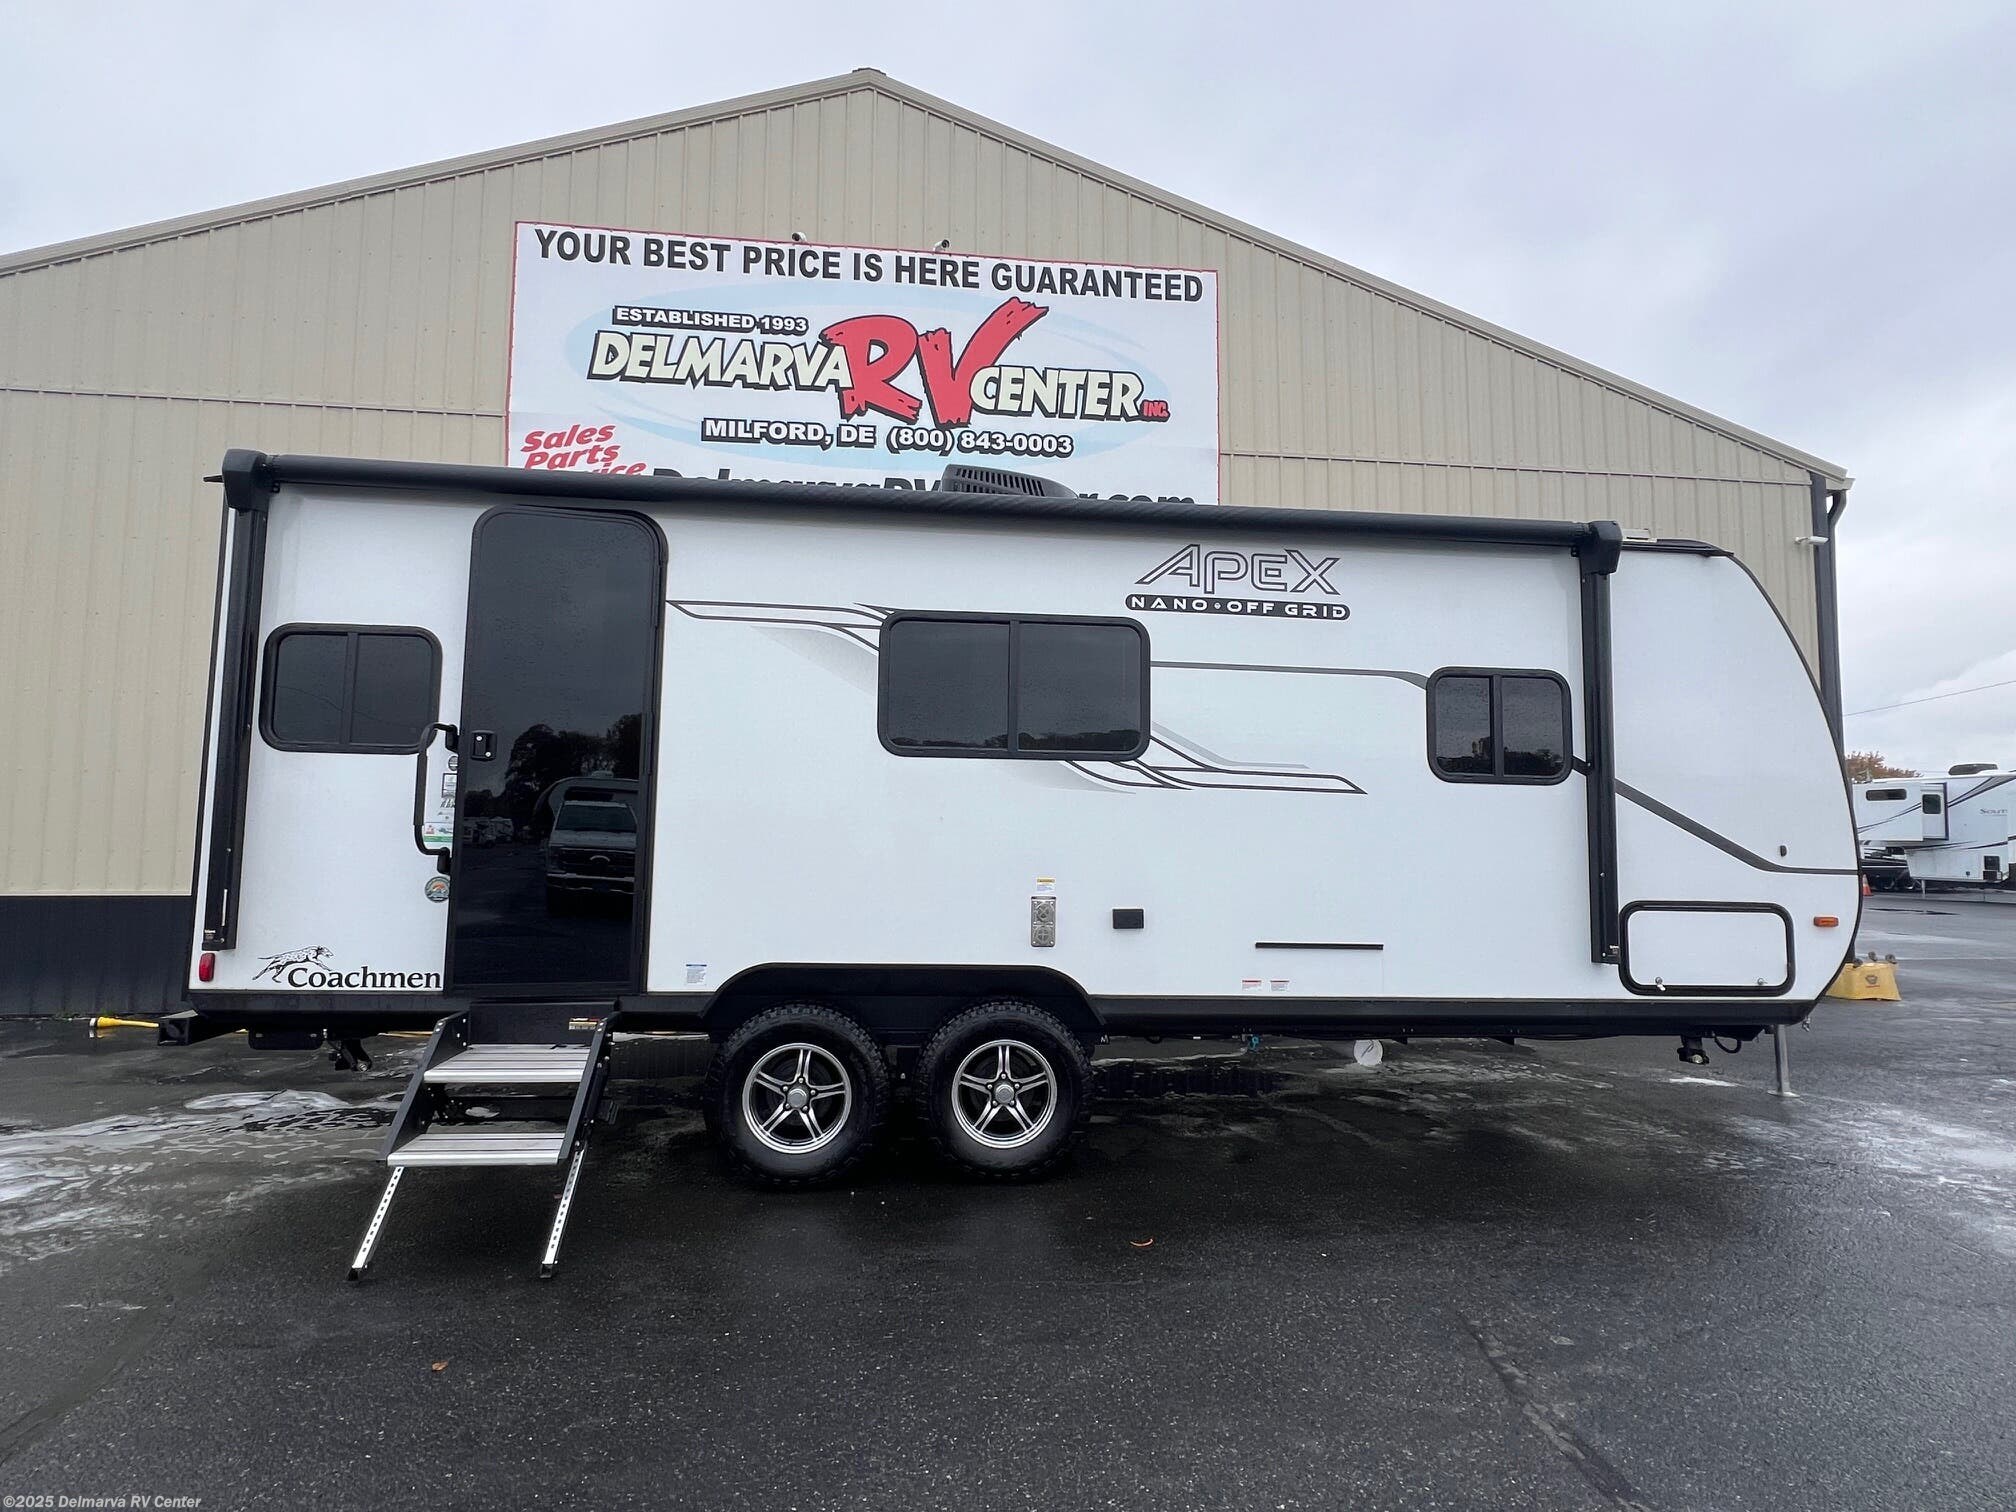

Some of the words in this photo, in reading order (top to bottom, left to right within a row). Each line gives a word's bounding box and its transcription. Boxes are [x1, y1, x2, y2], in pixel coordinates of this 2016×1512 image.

[535, 229, 631, 265] YOUR
[643, 238, 731, 272] BEST
[743, 245, 841, 279] PRICE
[853, 252, 883, 282] IS
[895, 255, 980, 288] HERE
[991, 263, 1203, 302] GUARANTEED
[614, 306, 756, 331] ESTABLISHED
[760, 315, 808, 334] 1993
[588, 330, 854, 391] DELMARVA
[819, 297, 1049, 427] RV
[969, 365, 1145, 420] CENTER
[520, 424, 616, 452] Sales
[702, 418, 833, 450] MILFORD,
[837, 424, 876, 448] DE
[887, 426, 954, 456] (800)
[957, 430, 1074, 458] 843-0003
[524, 444, 621, 471] Parts
[1134, 543, 1342, 596] APEX
[1284, 604, 1347, 618] GRID
[287, 965, 442, 989] Coachmen
